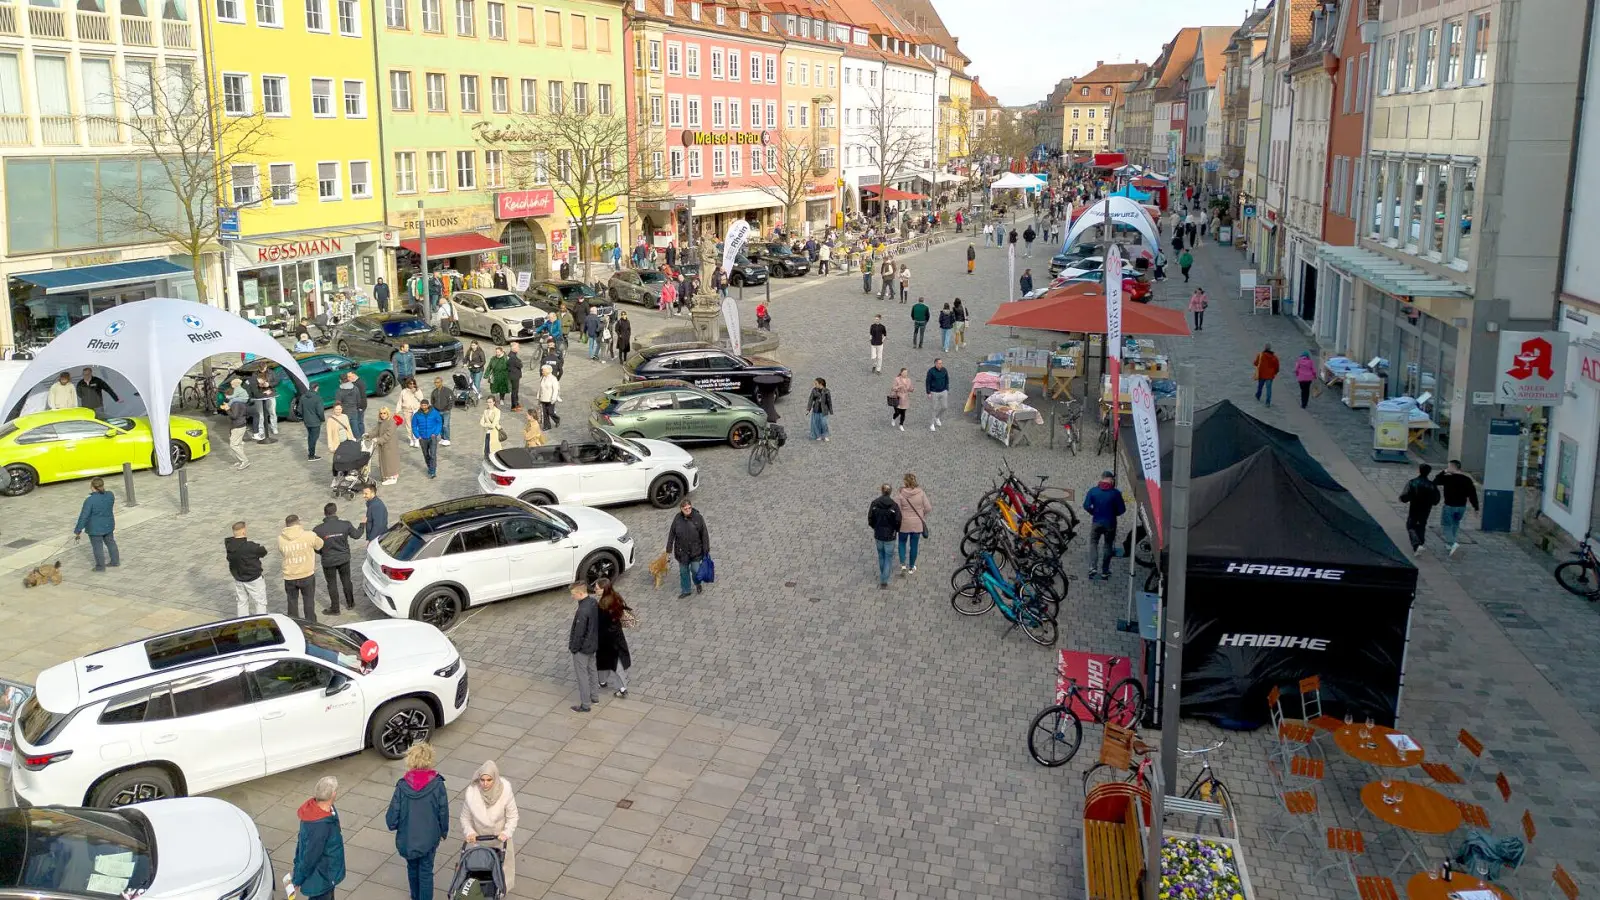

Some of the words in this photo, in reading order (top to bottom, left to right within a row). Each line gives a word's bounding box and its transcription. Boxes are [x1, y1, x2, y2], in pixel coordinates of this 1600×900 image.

[694, 131, 728, 145] Meisel
[736, 131, 761, 145] Bräu
[504, 194, 551, 211] Reichshof
[404, 217, 458, 231] FREHLIONS
[731, 225, 748, 248] Rhein
[258, 239, 341, 262] ROSSMANN
[87, 338, 120, 350] Rhein
[187, 329, 223, 344] Rhein
[1226, 562, 1345, 580] HAIBIKE
[1218, 633, 1332, 651] HAIBIKE
